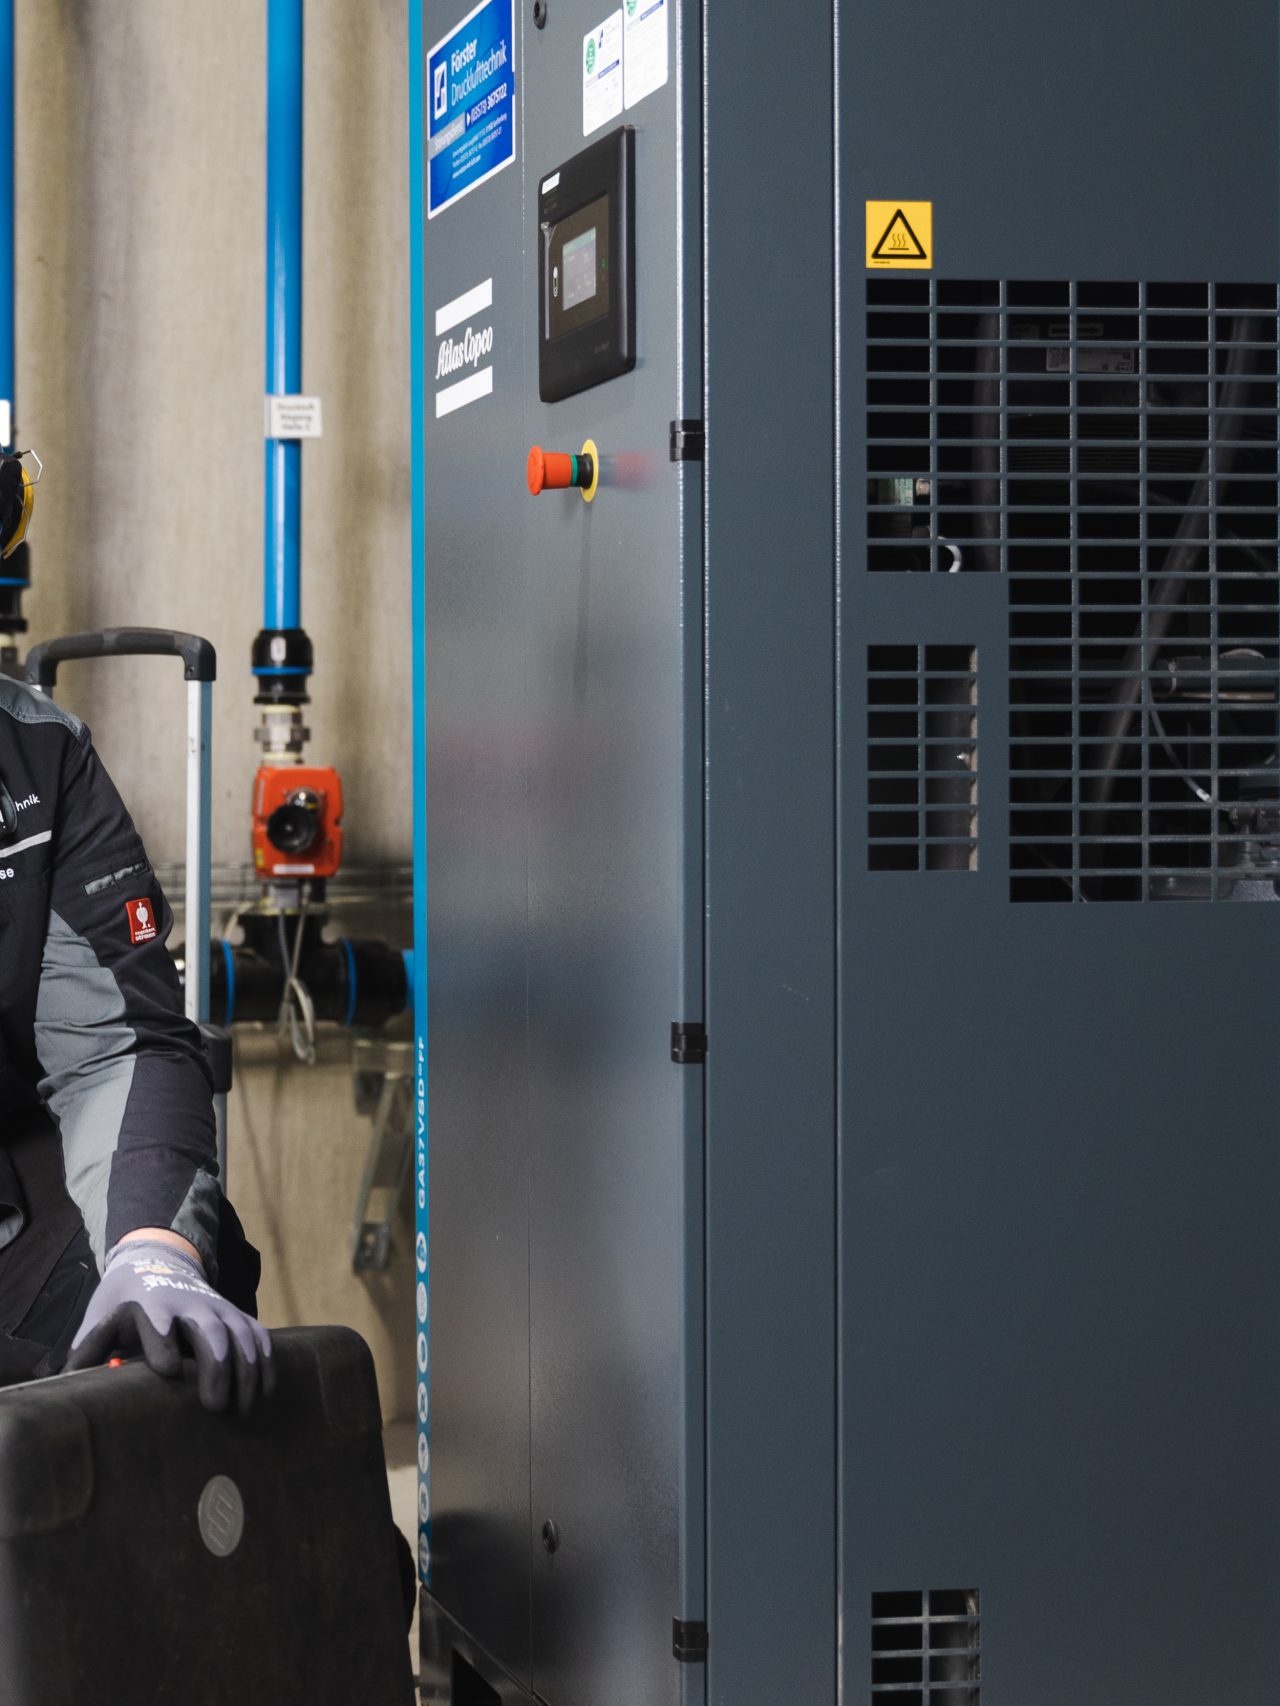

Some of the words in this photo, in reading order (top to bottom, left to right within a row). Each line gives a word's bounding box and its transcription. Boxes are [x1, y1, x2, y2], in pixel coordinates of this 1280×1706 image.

[451, 39, 477, 76] Förster
[452, 39, 507, 107] Drucklufttechnik
[435, 338, 464, 380] Atlas
[464, 326, 493, 367] Copco
